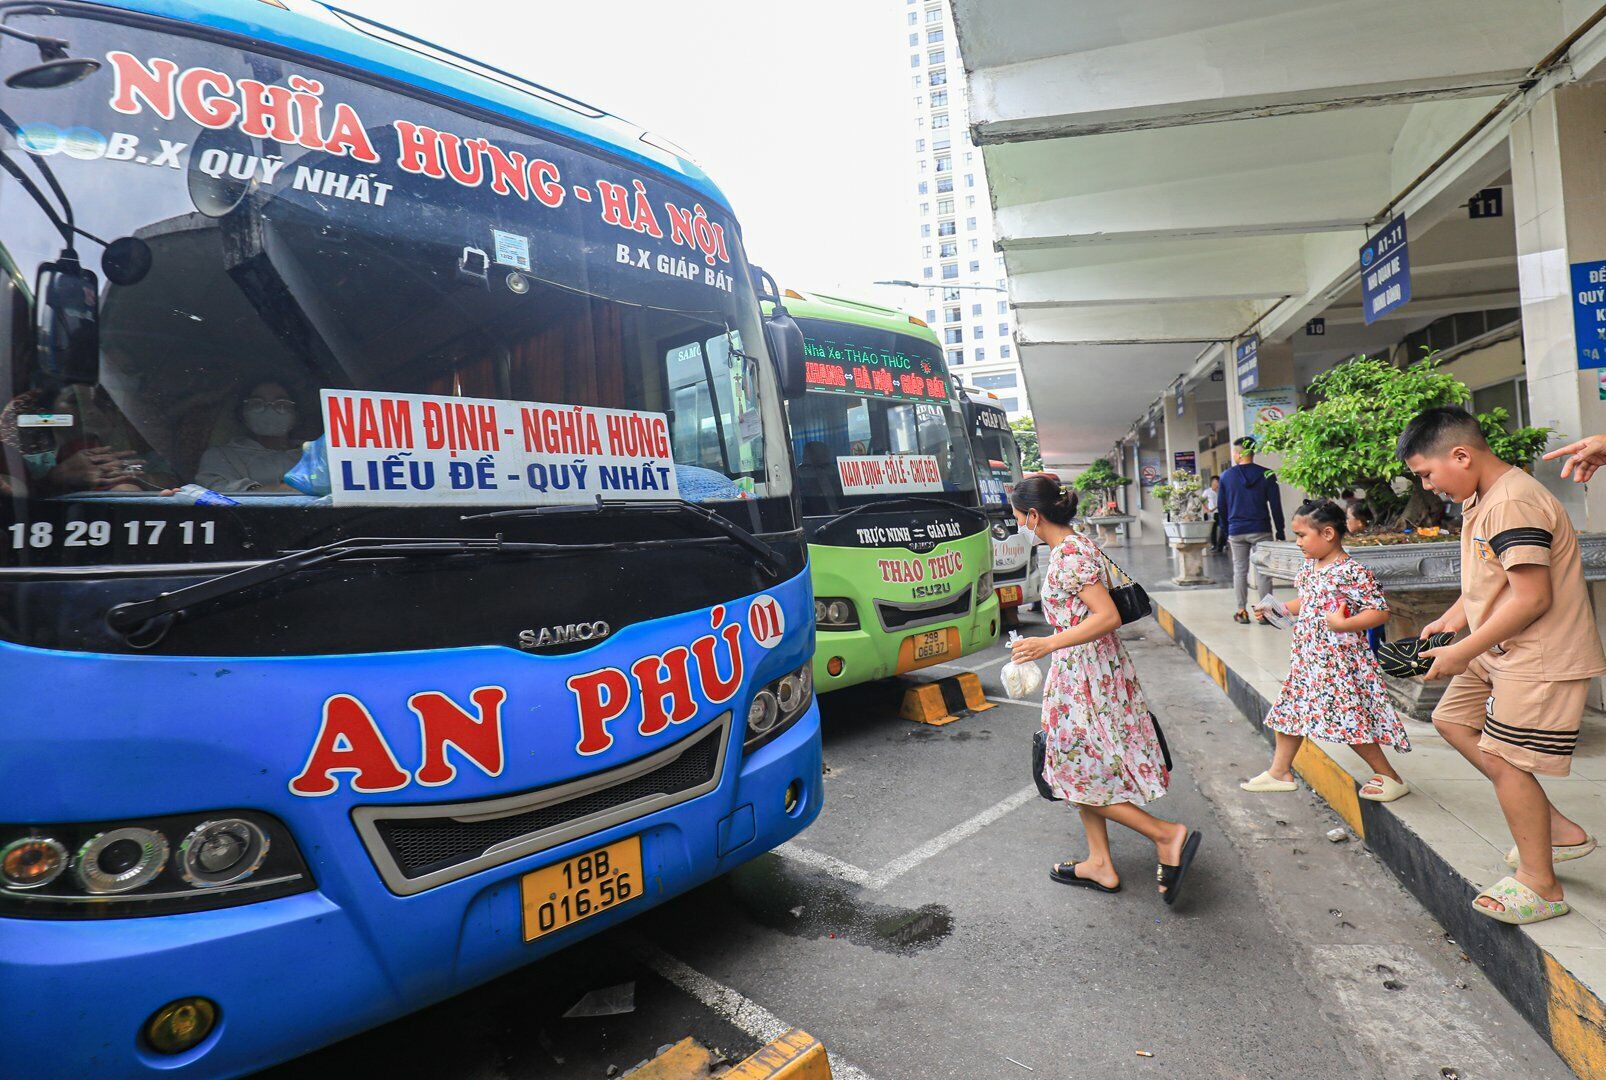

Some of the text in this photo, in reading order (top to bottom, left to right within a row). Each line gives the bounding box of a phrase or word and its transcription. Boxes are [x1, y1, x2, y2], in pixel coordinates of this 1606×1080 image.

[105, 132, 394, 207] B.X QUỸ NHẤT
[106, 51, 381, 164] NGHĨA
[393, 119, 565, 208] HƯNG
[597, 179, 663, 238] HÀ
[665, 203, 730, 266] NỘI
[1476, 199, 1497, 215] 11
[1378, 225, 1402, 255] A1-11
[616, 243, 734, 293] B.X GIÁP BÁT
[1578, 286, 1605, 306] QUÝ
[1310, 323, 1323, 334] 10
[804, 342, 826, 359] Nhà
[844, 349, 879, 365] THAO
[880, 353, 911, 370] THỨC
[853, 364, 872, 390] HÀ
[871, 368, 894, 396] NỘI
[327, 396, 414, 449] NAM
[423, 401, 500, 458] ĐỊNH
[521, 405, 603, 456] NGHĨA
[606, 412, 669, 459] HƯNG
[341, 452, 435, 491] LIỄU
[449, 454, 498, 491] ĐỀ
[527, 458, 588, 493] QUỸ
[600, 460, 671, 491] NHẤT
[839, 460, 863, 487] NAM
[8, 520, 215, 549] 18 29 17 11
[856, 518, 962, 547] TRỰC NINH GIÁP BÁT
[878, 557, 925, 583] THAO
[927, 547, 963, 580] THỨC
[911, 582, 951, 599] ISUZU
[519, 620, 611, 649] SAMCO
[749, 599, 783, 642] 01
[918, 642, 945, 657] 069.37
[288, 604, 745, 797] AN PHÚ
[562, 850, 610, 890] 18B
[538, 872, 632, 932] 016.56
